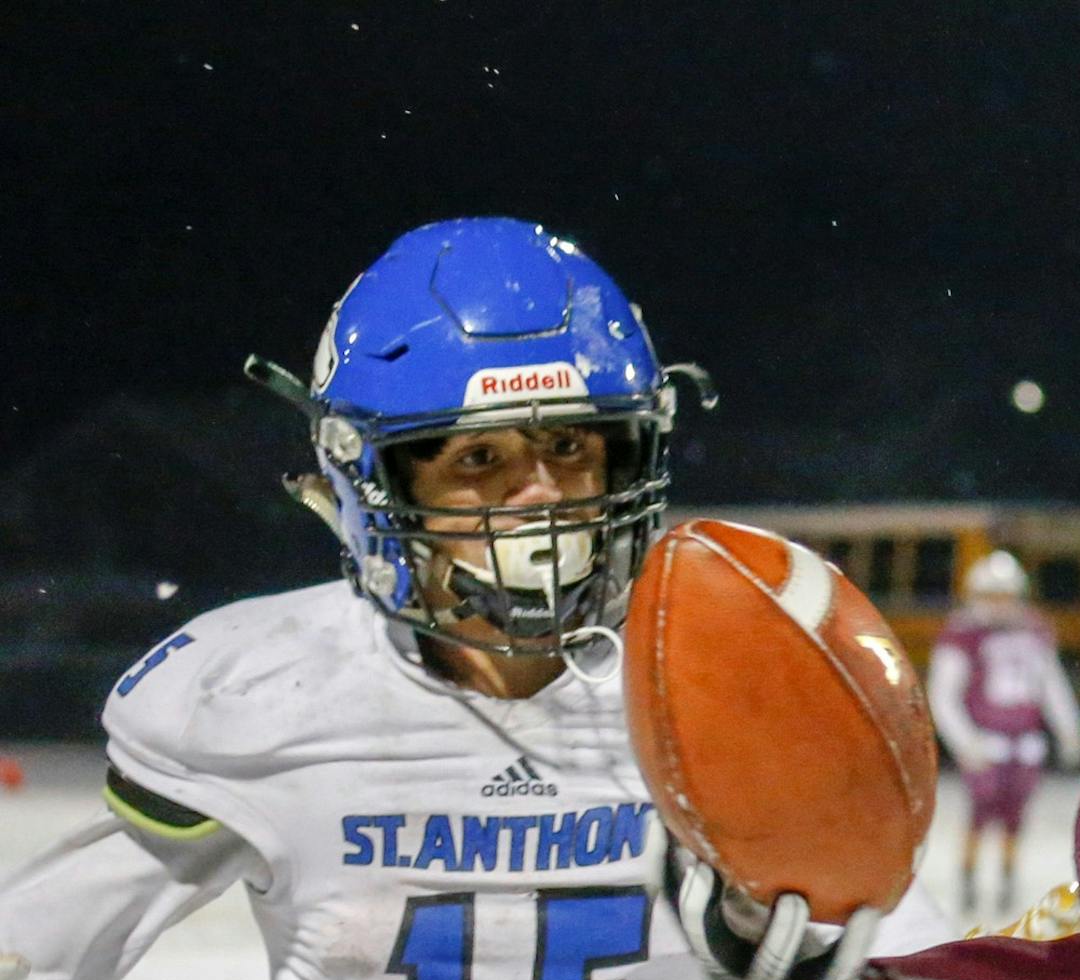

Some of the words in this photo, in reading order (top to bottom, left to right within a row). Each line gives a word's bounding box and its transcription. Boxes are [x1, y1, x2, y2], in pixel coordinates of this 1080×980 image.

[481, 369, 571, 395] Riddell
[480, 778, 558, 797] adidas
[342, 802, 655, 871] ST.ANTHON
